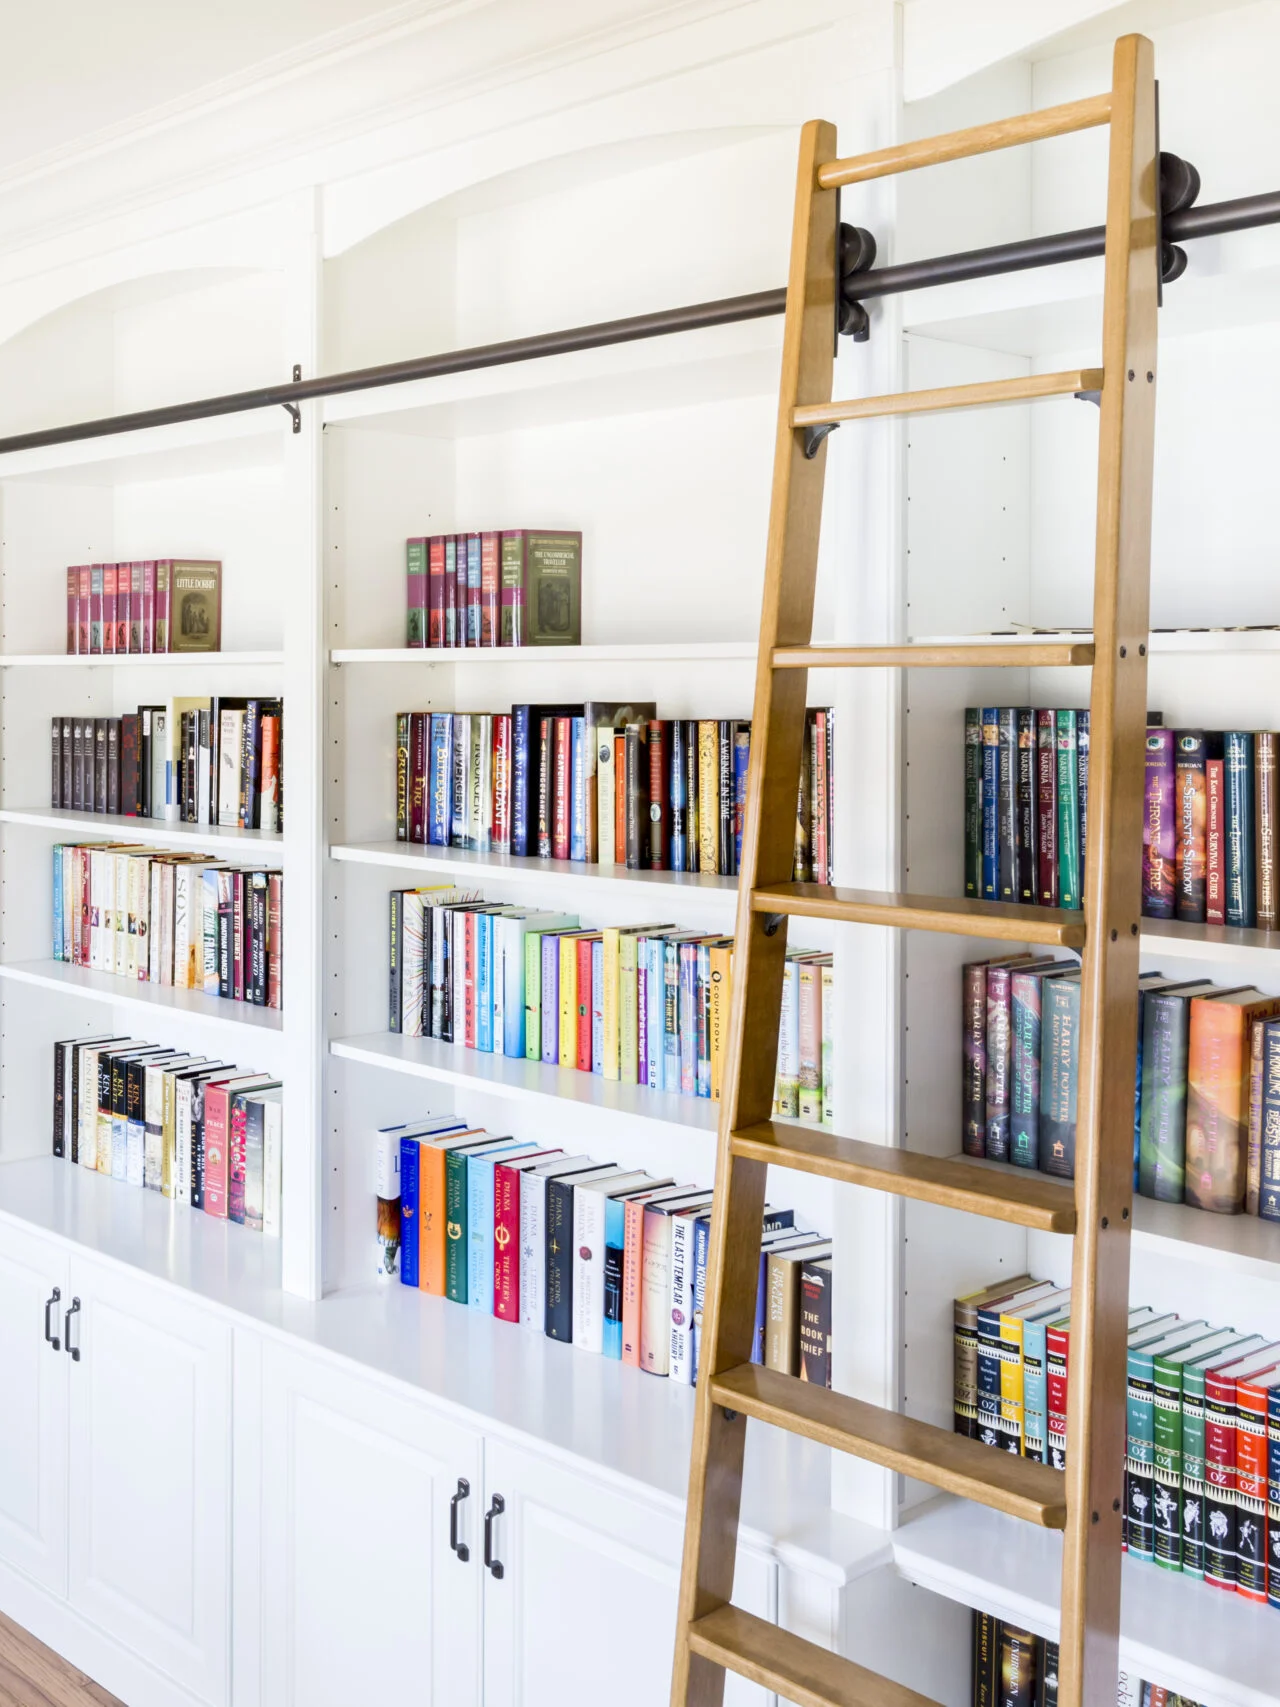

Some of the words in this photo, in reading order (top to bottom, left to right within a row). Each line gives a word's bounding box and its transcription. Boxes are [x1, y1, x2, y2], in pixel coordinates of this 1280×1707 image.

[177, 578, 195, 589] LITTLE
[721, 738, 729, 746] A
[721, 746, 729, 785] WRINKLE
[984, 750, 992, 781] NARNIA
[1059, 754, 1067, 786] NARNIA
[1078, 755, 1086, 787] NARNIA
[397, 747, 408, 820] GRACELING
[414, 776, 426, 808] FIRE
[455, 743, 464, 822] DIVERGENT
[721, 787, 729, 797] IN
[514, 802, 522, 836] MARK
[721, 798, 729, 820] TIME
[1149, 788, 1163, 845] THRONE
[1183, 786, 1195, 846] SERPENT'S
[1209, 831, 1219, 870] SURVIVAL
[1229, 831, 1241, 875] LIGHTNING
[1150, 857, 1163, 891] FIRE
[1183, 849, 1195, 896] SHADOW
[1209, 872, 1219, 899] GUIDE
[973, 998, 982, 1049] HARRY
[995, 1000, 1006, 1052] HARRY
[1023, 1008, 1033, 1060] HARRY
[1061, 1014, 1071, 1067] HARRY
[1160, 1029, 1170, 1086] HARRY
[102, 1074, 110, 1095] KEN
[973, 1052, 982, 1102] POTTER
[995, 1055, 1006, 1105] POTTER
[1023, 1063, 1033, 1114] POTTER
[1060, 1070, 1070, 1123] POTTER
[206, 1119, 224, 1128] PEACE
[1158, 1090, 1169, 1144] POTTER
[1266, 1109, 1280, 1146] BEASTS
[674, 1224, 685, 1241] THE
[698, 1229, 706, 1264] RAYMOND
[674, 1241, 685, 1264] LAST
[555, 1267, 561, 1278] AN
[673, 1265, 685, 1305] TEMPLAR
[696, 1265, 706, 1308] KHOURY
[800, 1325, 823, 1341] BOOK
[803, 1310, 819, 1324] THE
[800, 1340, 823, 1357] THIEF
[981, 1400, 995, 1409] OZ
[1051, 1390, 1063, 1398] Road
[1210, 1404, 1226, 1412] BAUM
[1050, 1420, 1064, 1431] OZ
[1239, 1412, 1255, 1421] BAUM
[1243, 1435, 1252, 1443] The
[1184, 1461, 1200, 1475] OZ
[1210, 1471, 1227, 1484] OZ
[1239, 1480, 1256, 1494] OZ
[1010, 1639, 1020, 1697] UNBROKEN
